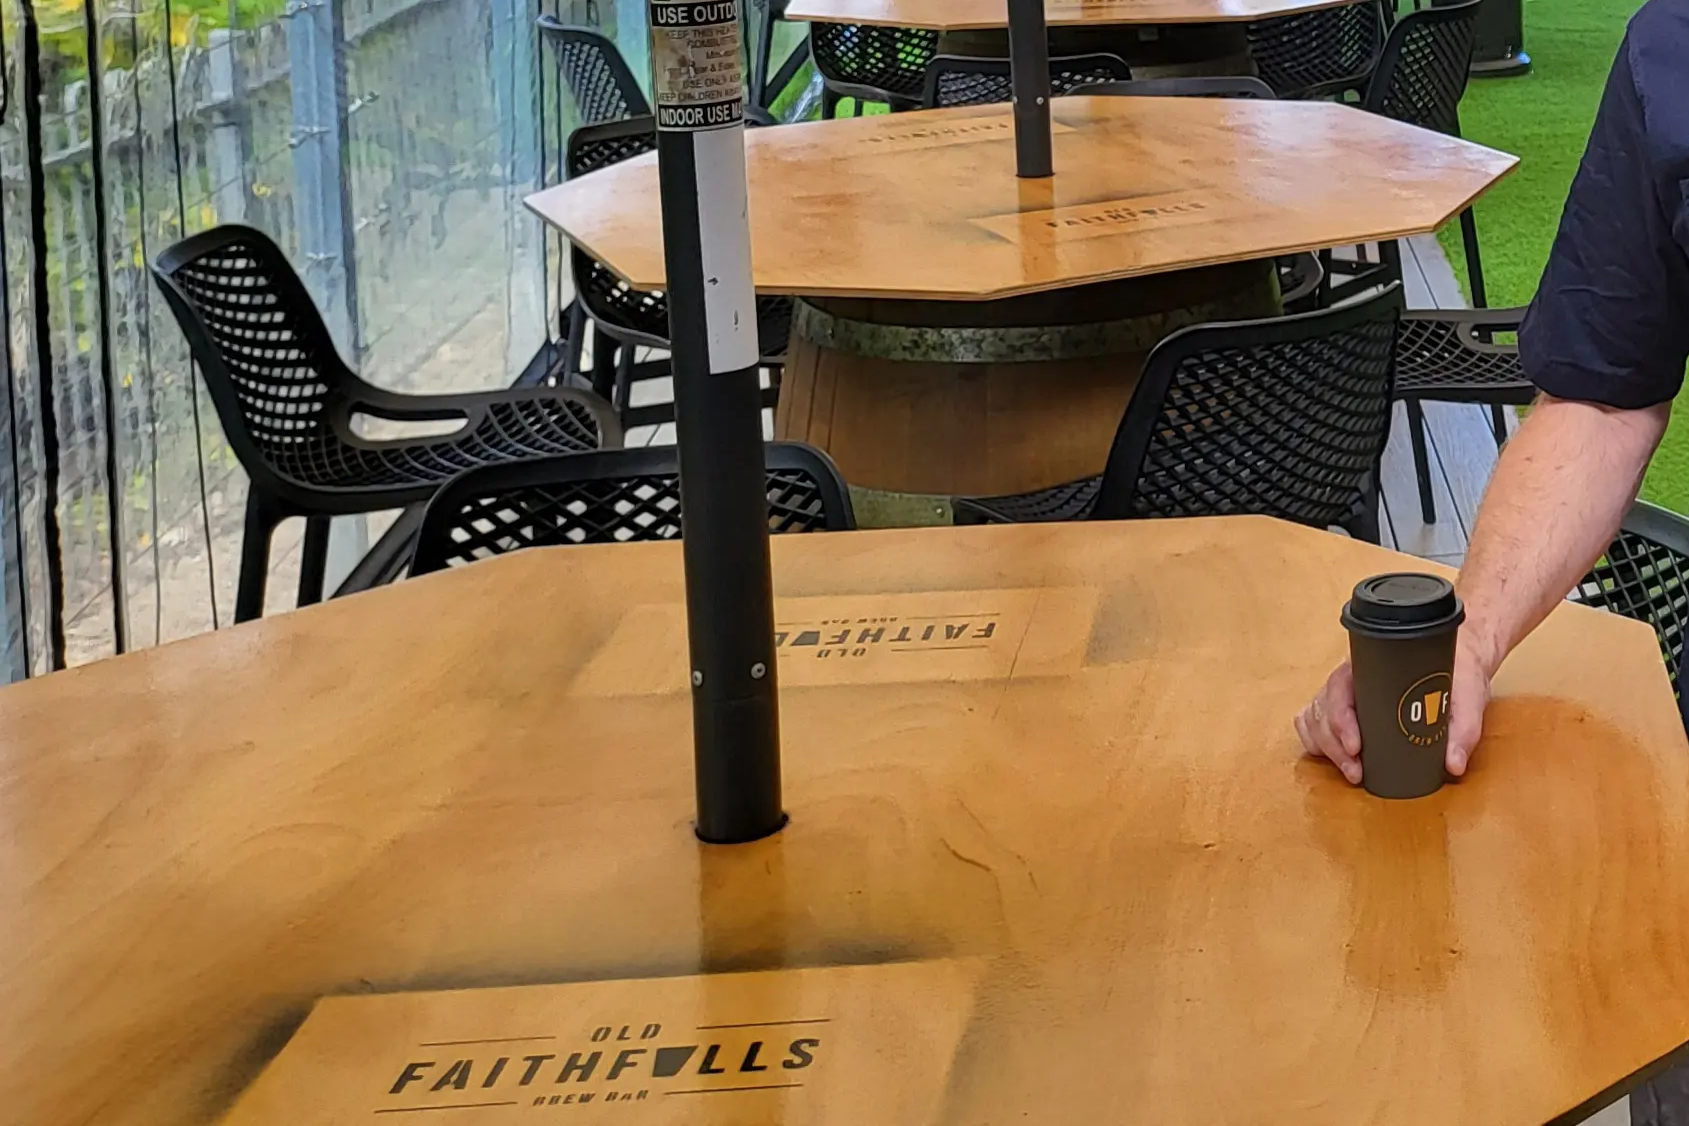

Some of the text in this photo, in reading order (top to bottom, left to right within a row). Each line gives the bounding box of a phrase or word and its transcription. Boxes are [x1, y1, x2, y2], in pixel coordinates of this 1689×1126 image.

[657, 6, 690, 24] USE
[660, 107, 704, 126] INDOOR
[707, 104, 731, 124] USE
[816, 647, 867, 659] OLD
[591, 1023, 662, 1043] OLD
[532, 1089, 649, 1107] BREW BAR
